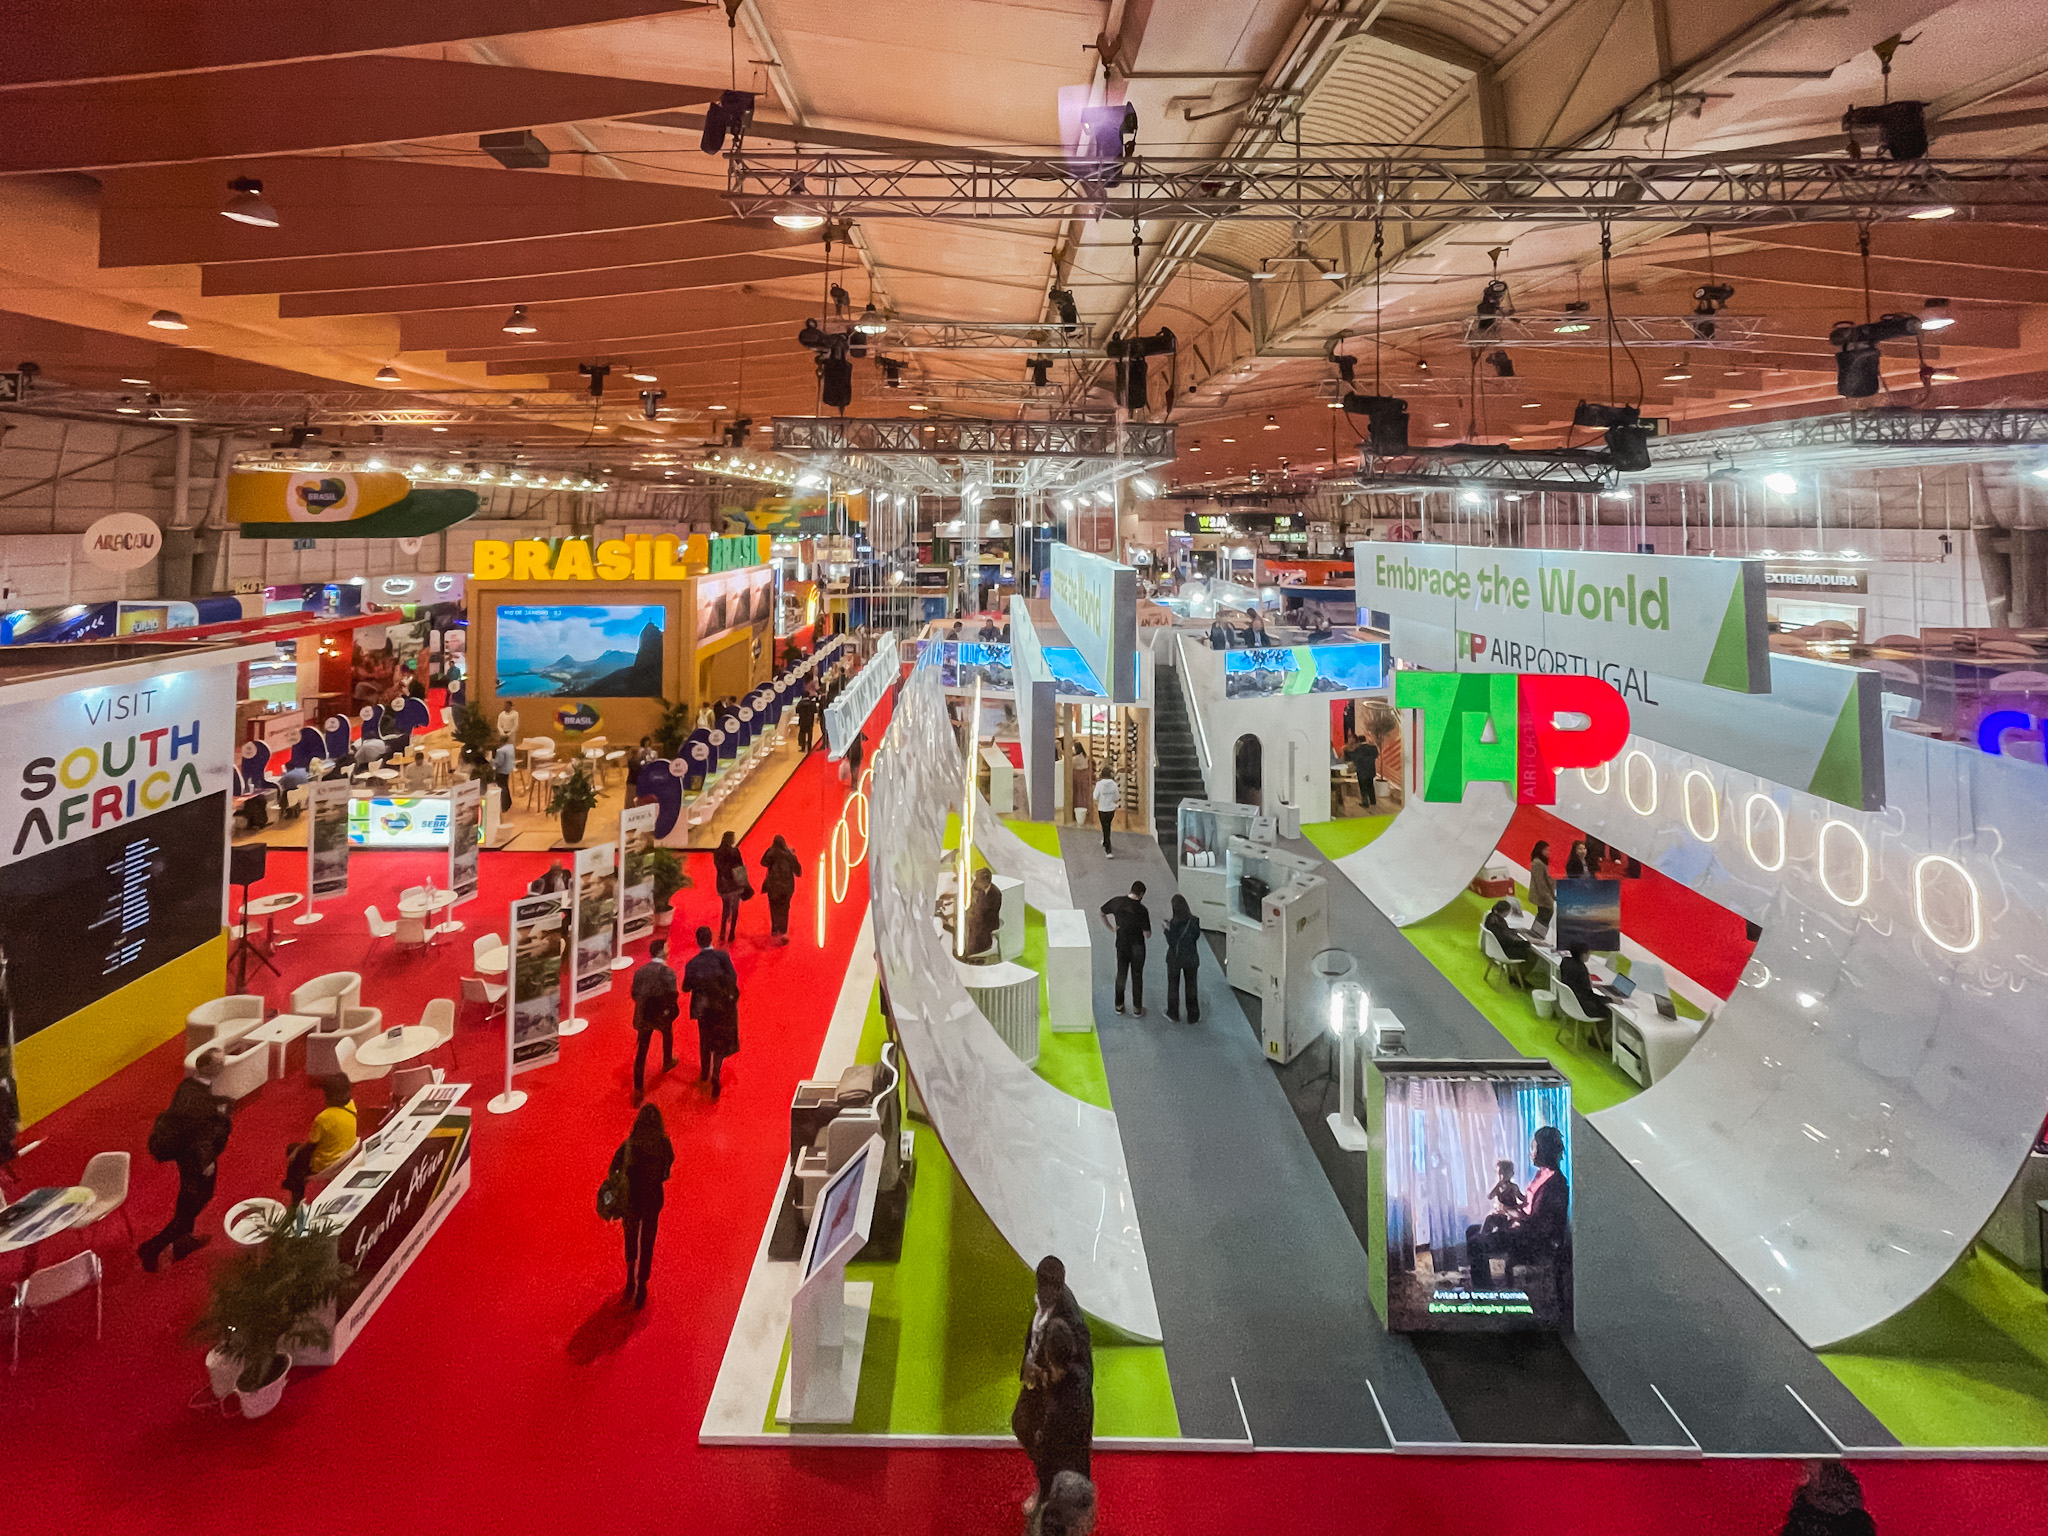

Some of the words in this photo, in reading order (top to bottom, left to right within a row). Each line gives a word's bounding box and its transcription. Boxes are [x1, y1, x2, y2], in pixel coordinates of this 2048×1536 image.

[308, 492, 337, 501] BRASIL
[1198, 516, 1228, 527] W2M
[473, 539, 687, 581] BRASIL
[711, 534, 762, 575] BRASIL
[1375, 554, 1471, 600] Embrace
[1477, 564, 1531, 609] the
[1538, 566, 1670, 631] World
[1764, 572, 1858, 587] EXTREMADURA
[84, 690, 157, 725] VISIT
[564, 716, 593, 725] BRASIL
[1396, 671, 1631, 806] TAP
[20, 719, 200, 801] SOUTH
[12, 762, 203, 855] AFRICA
[404, 1148, 445, 1211] Africa
[1428, 1303, 1457, 1313] Before
[1457, 1304, 1504, 1315] exchanging
[1433, 1290, 1458, 1300] Antes
[1471, 1291, 1499, 1300] trocar
